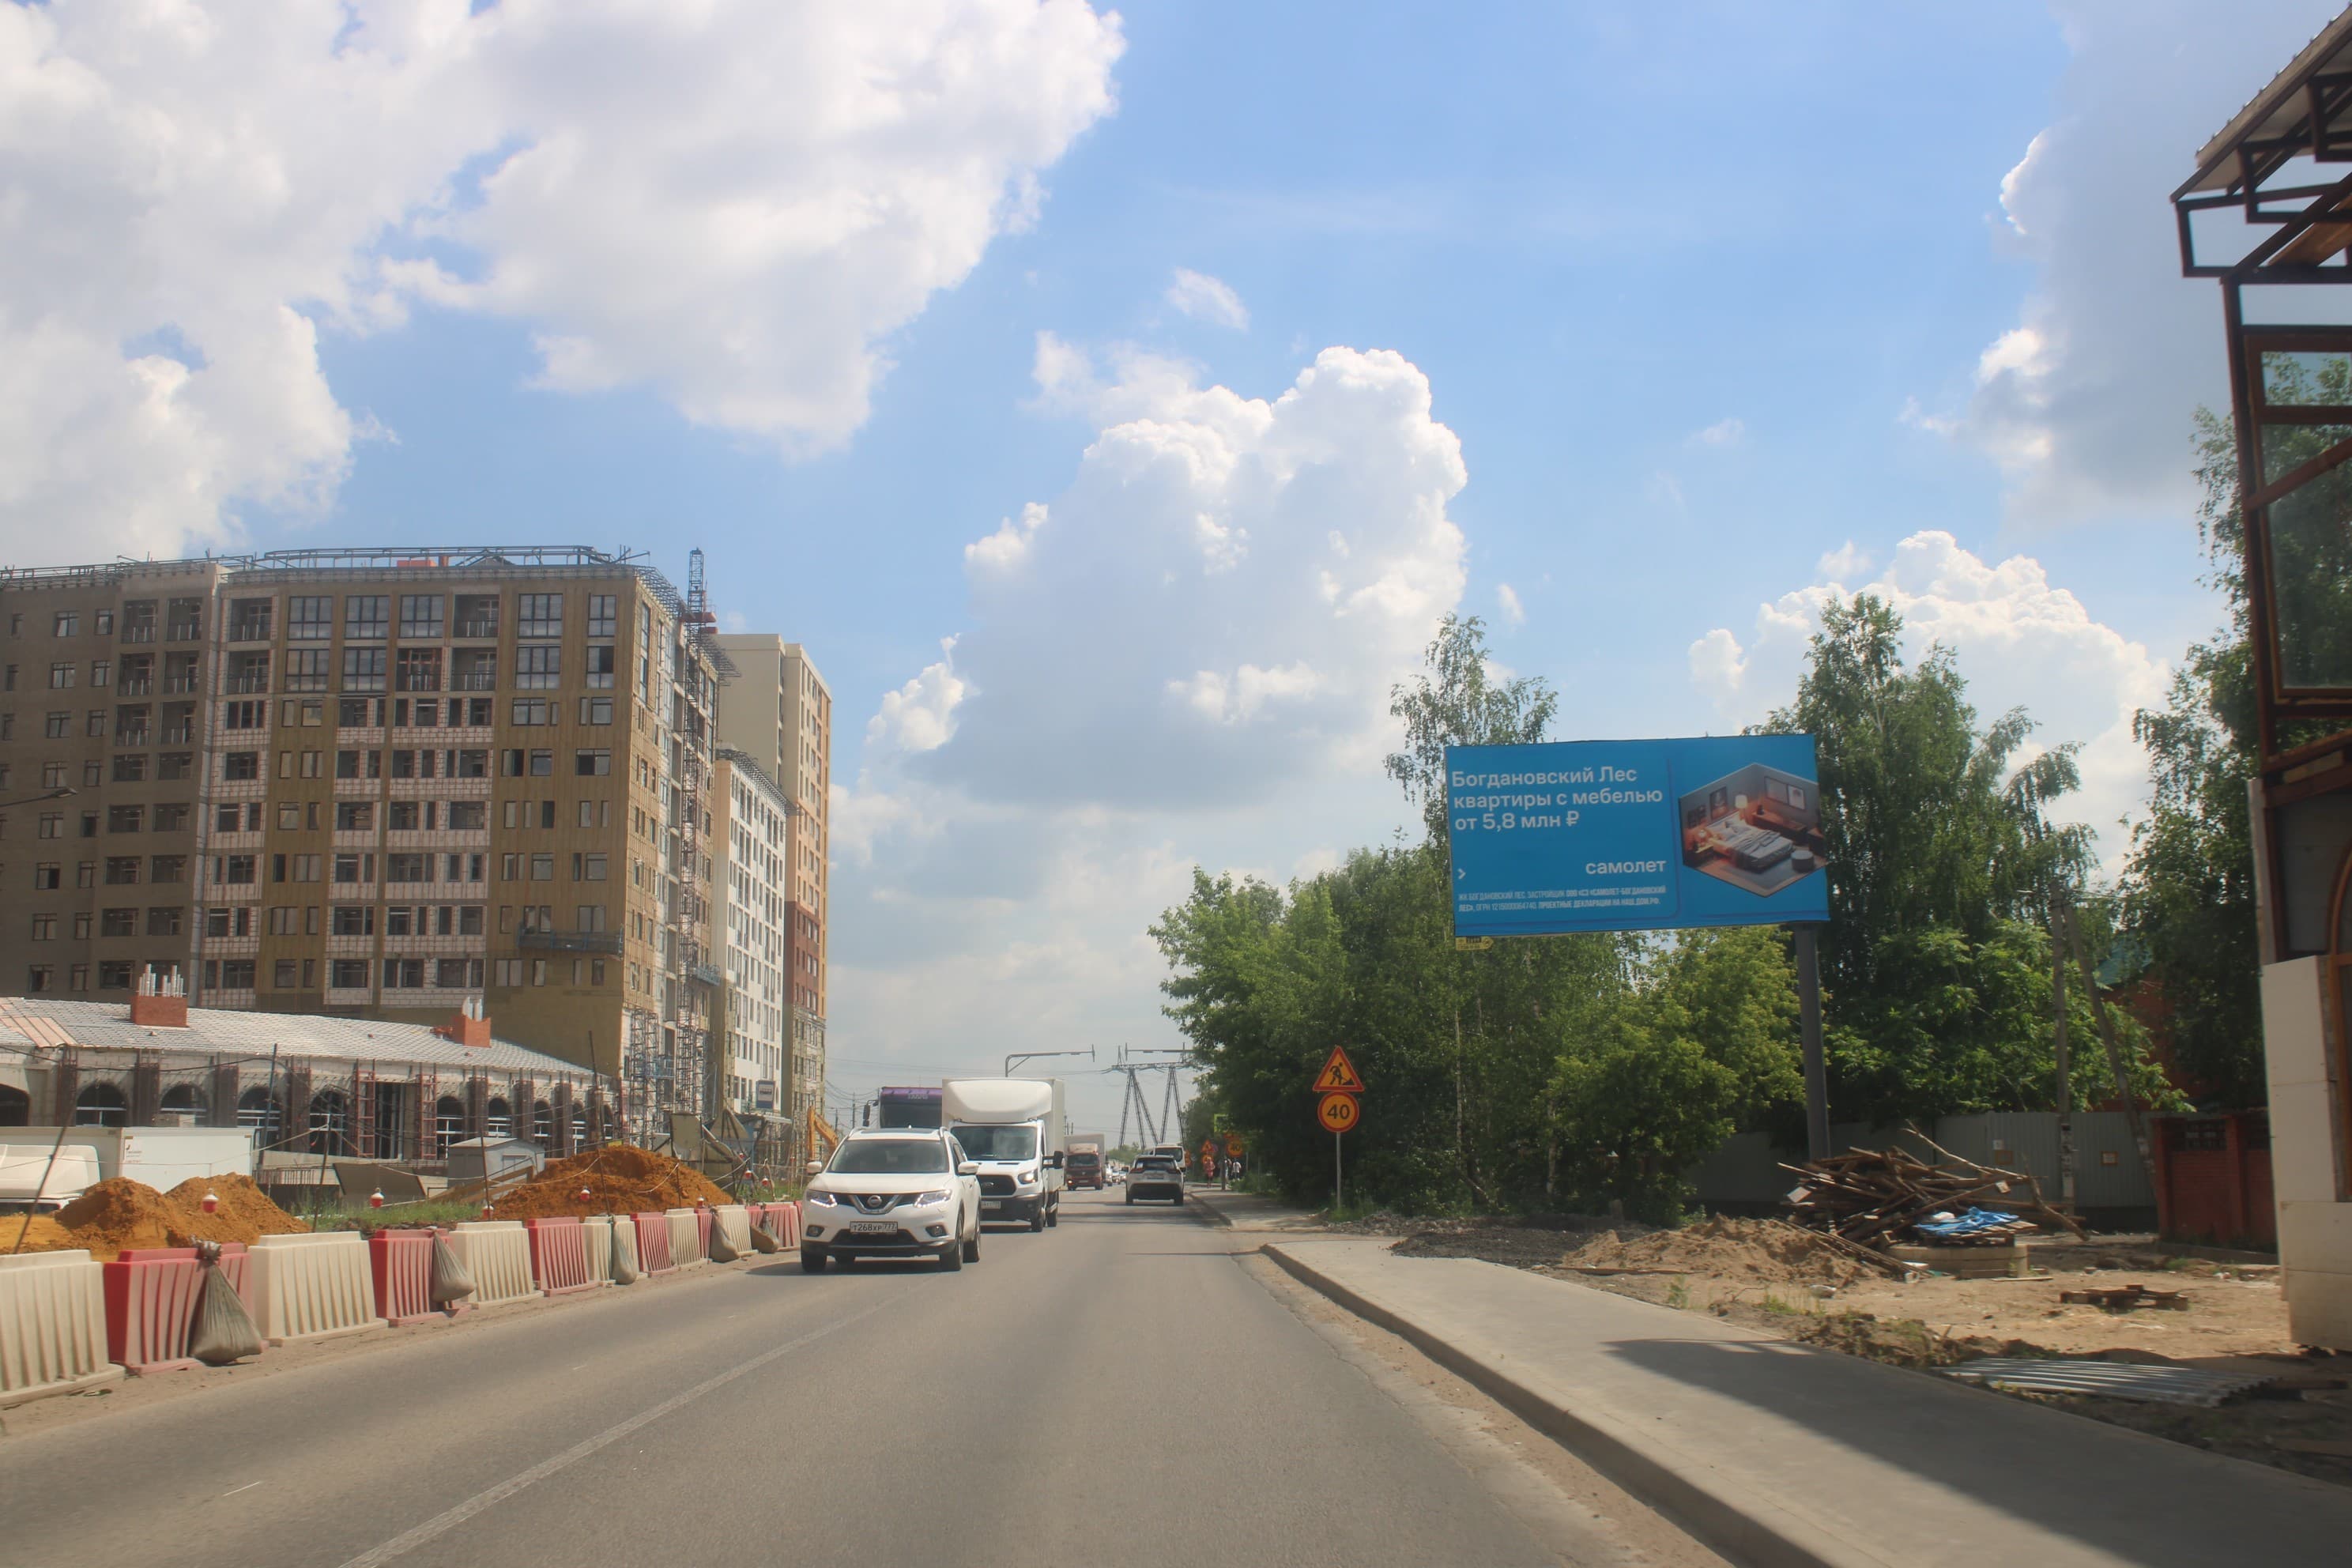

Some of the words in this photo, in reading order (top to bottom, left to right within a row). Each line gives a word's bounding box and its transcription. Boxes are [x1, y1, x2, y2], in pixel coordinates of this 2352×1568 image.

[1452, 767, 1593, 789] Богдановский
[1599, 766, 1638, 782] Лес
[1454, 793, 1551, 811] квартиры
[1556, 793, 1568, 805] с
[1573, 787, 1663, 805] мебелью
[1455, 817, 1477, 831] от
[1482, 812, 1516, 832] 5,8
[1521, 815, 1562, 828] млн
[1585, 860, 1667, 875] самолет
[1327, 1104, 1350, 1120] 40
